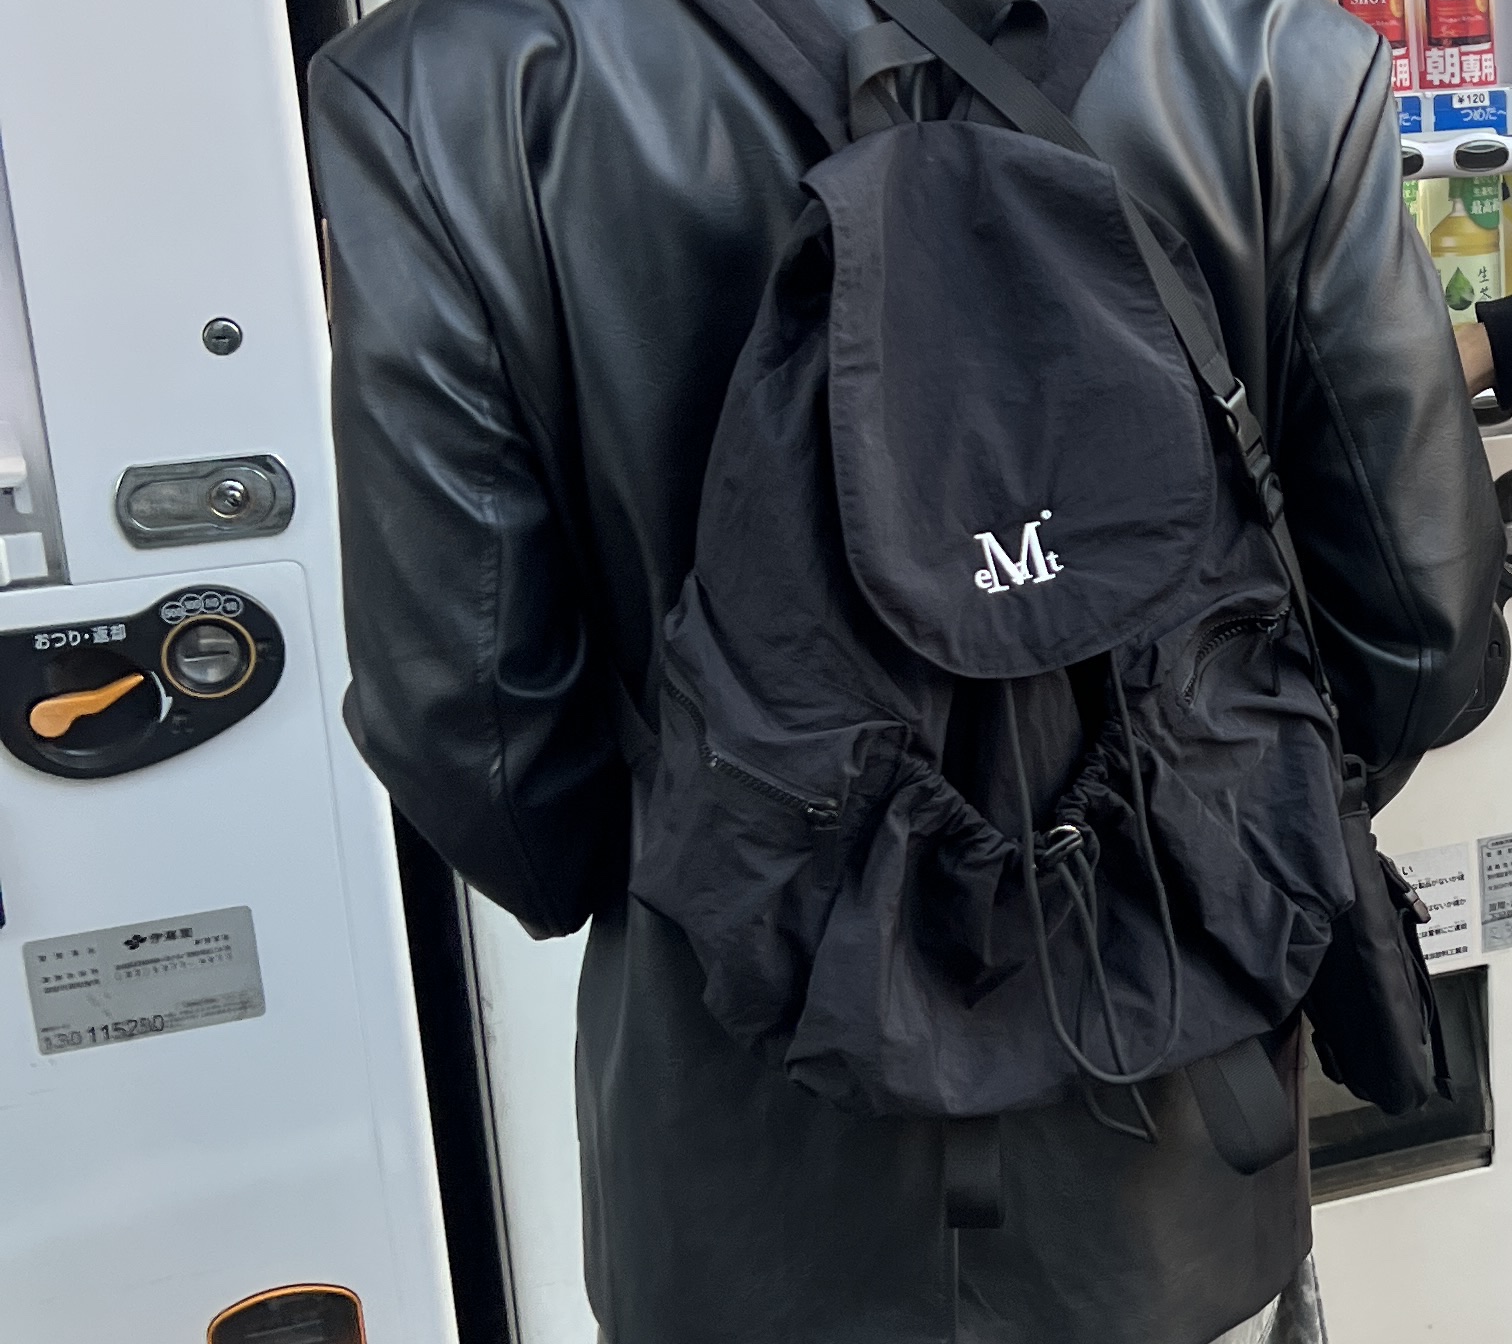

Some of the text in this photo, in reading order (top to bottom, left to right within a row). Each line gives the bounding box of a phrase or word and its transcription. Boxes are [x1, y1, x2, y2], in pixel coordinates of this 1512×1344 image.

[1424, 47, 1496, 87] 朝専用
[1457, 93, 1486, 105] ¥120
[34, 623, 127, 650] おつり・返却
